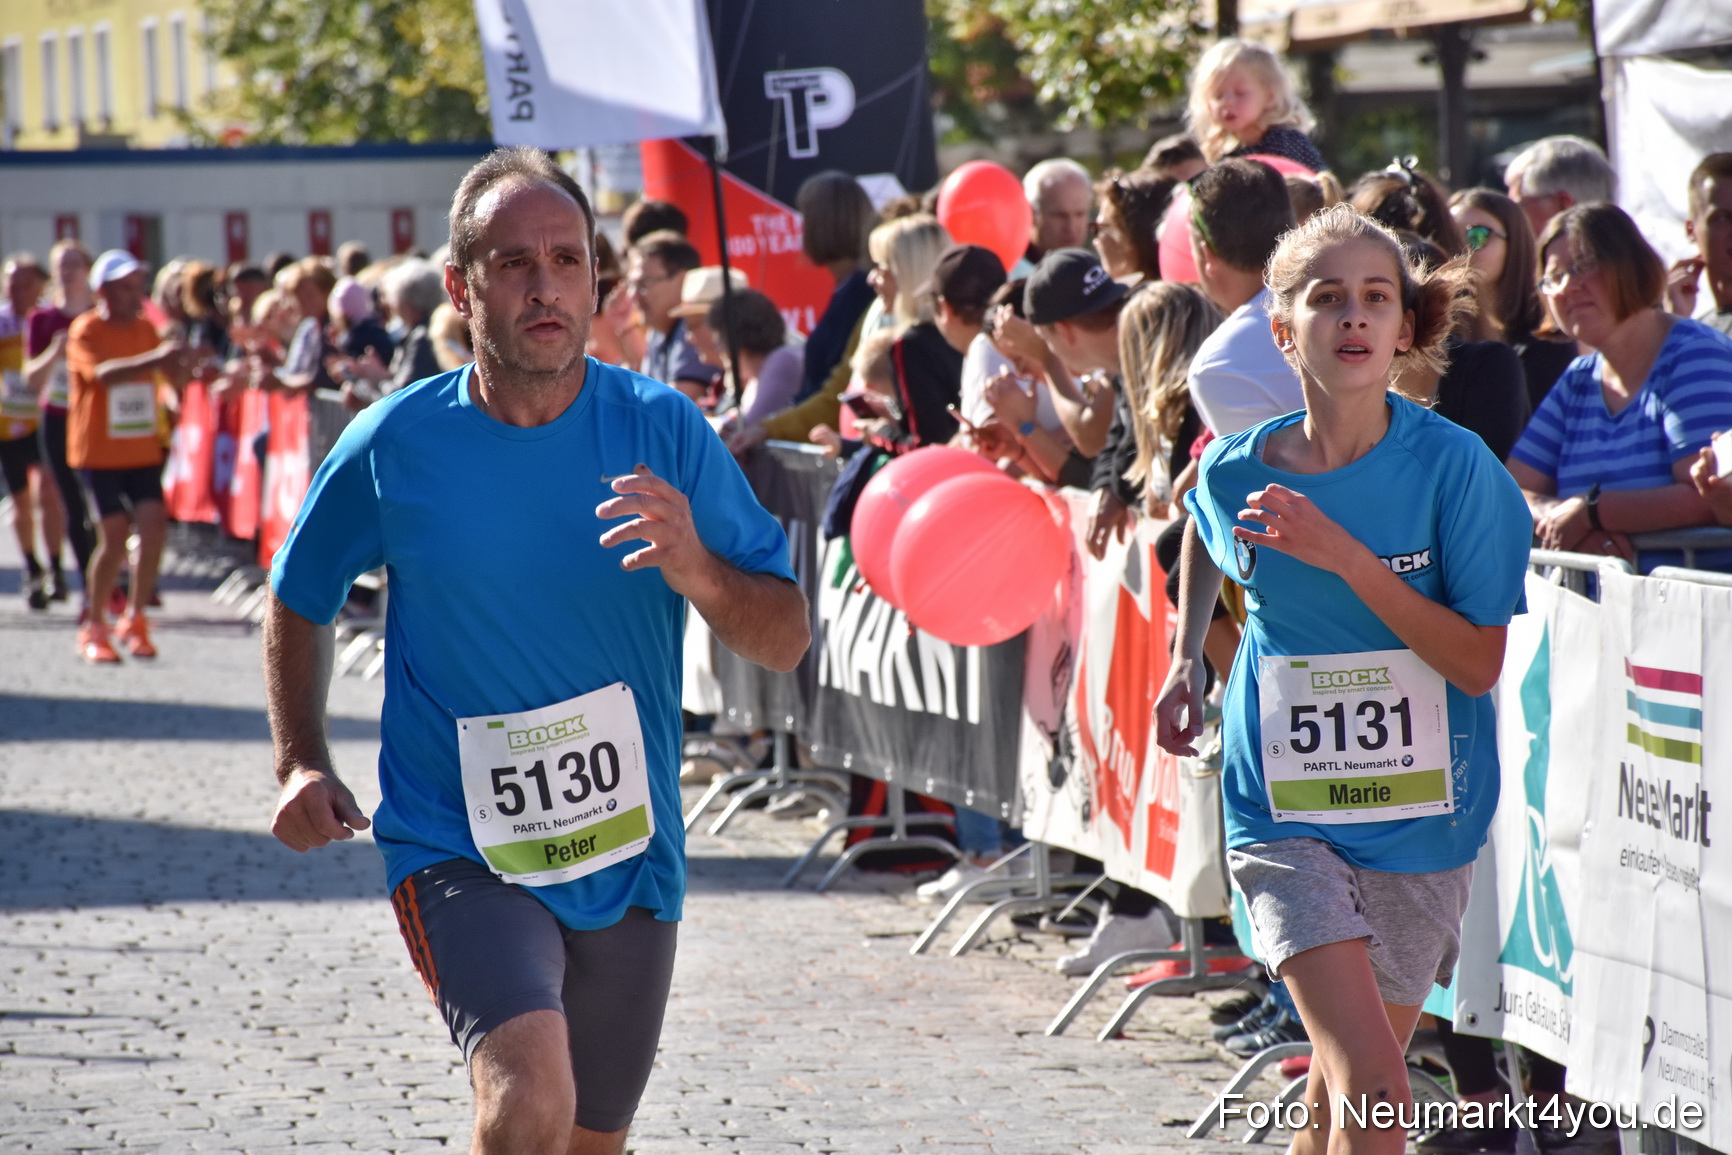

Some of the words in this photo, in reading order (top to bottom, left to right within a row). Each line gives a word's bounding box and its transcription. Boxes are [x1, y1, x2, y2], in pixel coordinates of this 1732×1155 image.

[1311, 667, 1392, 689] BOCK
[1312, 688, 1337, 696] inspired
[507, 714, 588, 749] BOCK
[1290, 697, 1413, 754] 5131
[510, 746, 536, 756] inspired
[536, 744, 545, 752] by
[546, 741, 563, 750] smart
[564, 732, 590, 744] concepts
[491, 741, 620, 816] 5130
[1304, 761, 1342, 772] PARTL
[1345, 758, 1398, 771] Neumarkt
[1329, 782, 1391, 806] Marie
[513, 821, 551, 835] PARTL
[553, 806, 603, 829] Neumarkt
[544, 834, 597, 865] Peter
[1493, 982, 1523, 1018] Jura
